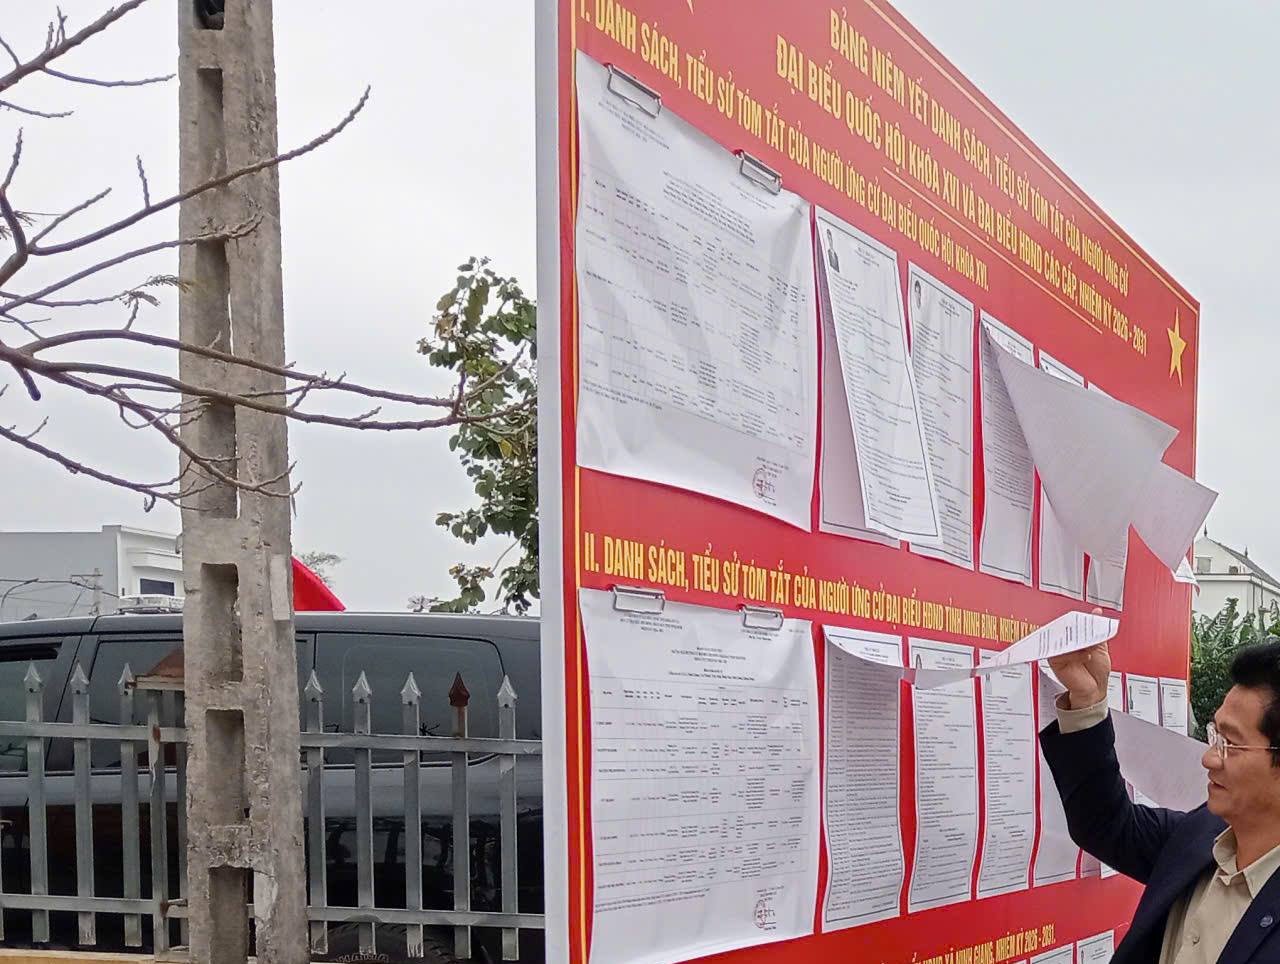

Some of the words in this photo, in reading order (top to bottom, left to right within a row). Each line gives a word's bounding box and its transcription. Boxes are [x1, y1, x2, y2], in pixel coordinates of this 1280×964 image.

[595, 0, 637, 53] DANH
[641, 22, 682, 88] SÁCH,
[686, 49, 714, 105] TIỂU
[717, 71, 737, 119] SỬ
[736, 88, 762, 139] TÓM
[765, 103, 785, 152] TẮT
[788, 120, 810, 170] CỦA
[812, 142, 844, 192] NGƯỜI
[846, 160, 865, 207] ỨNG
[867, 176, 880, 217] CỬ
[881, 190, 896, 232] ĐẠI
[898, 199, 917, 242] BIỂU
[918, 217, 939, 257] QUỐC
[941, 230, 954, 271] HỘI
[955, 239, 975, 280] KHÓA
[777, 33, 803, 94] ĐẠI
[808, 59, 842, 120] BIỂU
[845, 90, 881, 150] QUỐC
[884, 121, 906, 173] HỘI
[908, 140, 940, 196] KHÓA
[943, 167, 959, 211] XVI
[962, 183, 976, 224] VÀ
[978, 196, 994, 241] ĐẠI
[996, 211, 1017, 254] BIỂU
[1019, 229, 1042, 274] HĐND
[1044, 249, 1060, 289] CÁC
[1079, 280, 1102, 322] NHIỆM
[1112, 306, 1129, 343] 2026
[1132, 324, 1147, 357] 2031
[830, 6, 869, 76] BẢNG
[872, 46, 905, 108] NIÊM
[908, 77, 929, 126] YẾT
[931, 98, 961, 154] DANH
[964, 127, 993, 185] SÁCH,
[994, 152, 1015, 199] TIỂU
[1017, 171, 1029, 211] SỬ
[1029, 186, 1048, 229] TÓM
[1050, 200, 1064, 241] TẮT
[1066, 215, 1081, 256] CỦA
[1081, 236, 1103, 276] NGƯỜI
[1104, 248, 1119, 292] ỨNG
[1119, 263, 1129, 297] CỬ
[584, 531, 599, 573] II.
[604, 536, 644, 580] DANH
[648, 539, 689, 592] SÁCH,
[692, 542, 720, 593] TIỂU
[722, 551, 740, 597] SỬ
[741, 559, 767, 602] TÓM
[770, 559, 791, 605] TẮT
[793, 565, 817, 610] CỦA
[819, 576, 850, 616] NGƯỜI
[851, 580, 871, 619] ỨNG
[872, 582, 885, 622] CỬ
[886, 593, 901, 630] ĐẠI
[902, 588, 921, 627] BIỂU
[922, 600, 944, 630] HĐND
[945, 597, 962, 634] TỈNH
[963, 609, 981, 637] NINH
[1024, 928, 1038, 954] 2026
